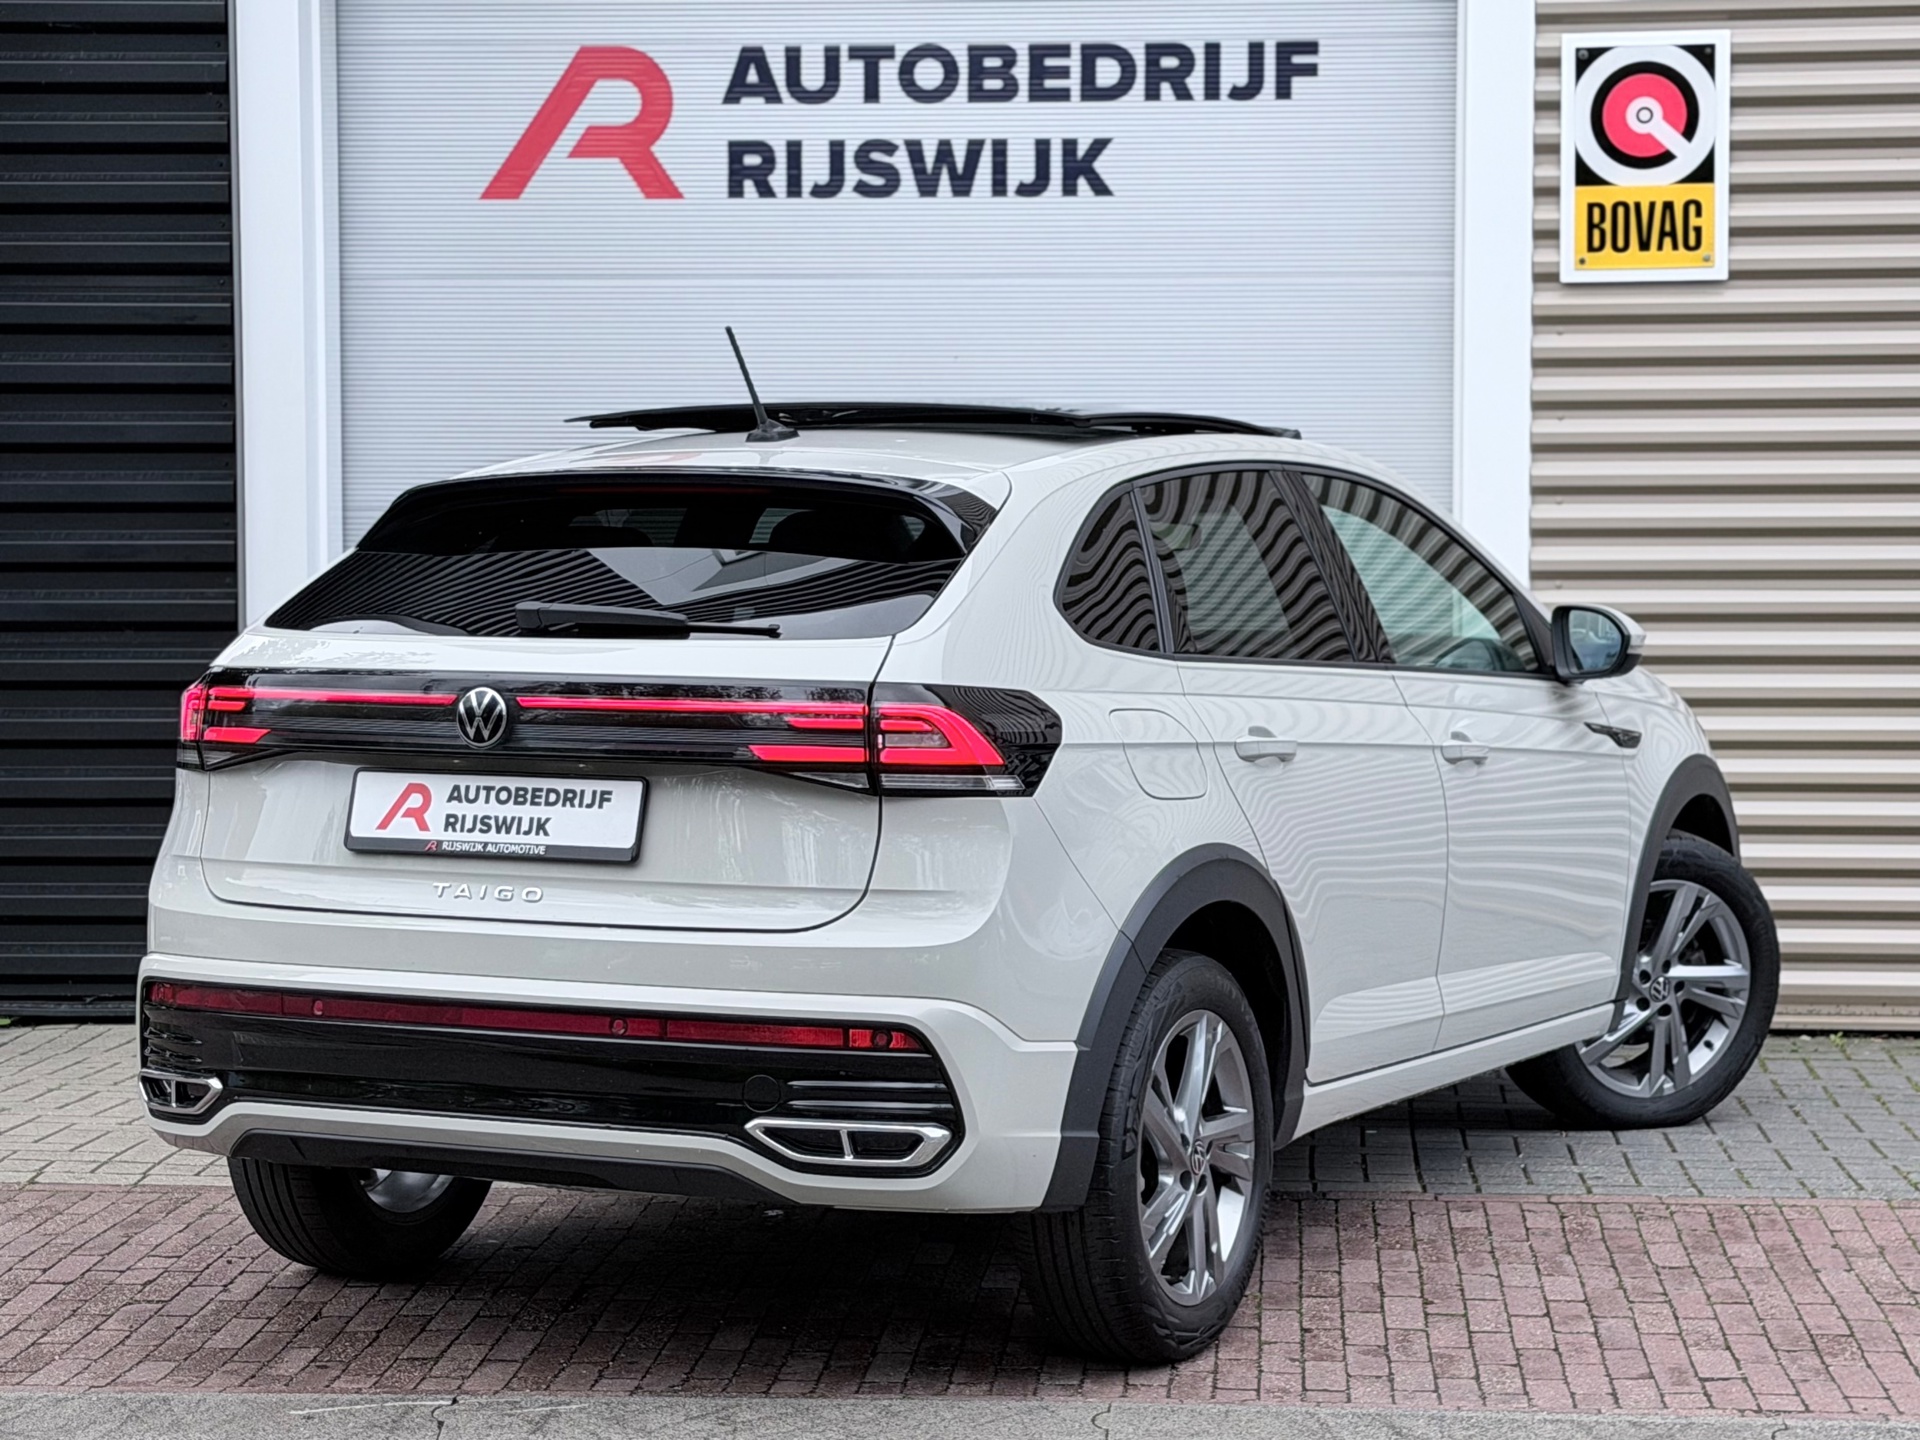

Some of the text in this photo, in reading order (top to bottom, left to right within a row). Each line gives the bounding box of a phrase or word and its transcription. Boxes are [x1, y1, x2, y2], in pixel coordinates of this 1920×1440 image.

[723, 41, 1320, 104] AUTOBEDRIJF
[727, 138, 1114, 198] RIJSWIJK
[1587, 199, 1703, 253] BOVAG
[446, 784, 613, 809] AUTOBEDRIJF
[443, 813, 552, 837] RIJSWIJK
[442, 841, 547, 855] RIJSWIJK AUTOMOTIVE
[432, 882, 544, 904] TAIGO
